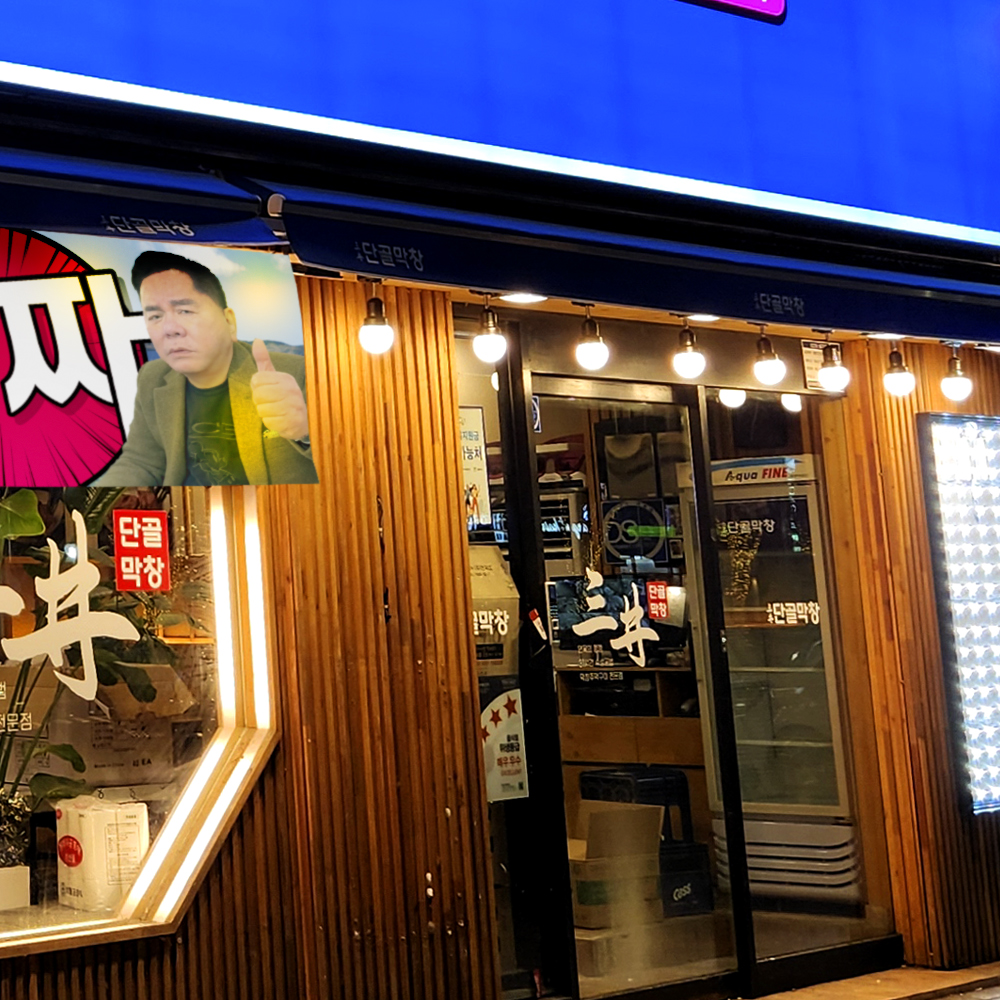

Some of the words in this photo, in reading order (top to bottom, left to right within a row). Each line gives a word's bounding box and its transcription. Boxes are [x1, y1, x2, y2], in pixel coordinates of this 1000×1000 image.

[109, 215, 195, 237] 단골막창
[362, 242, 424, 272] 단골막창
[760, 293, 805, 317] 단골막창
[725, 471, 758, 482] Aqua
[762, 468, 788, 479] FINE
[119, 516, 163, 548] 단골
[728, 519, 775, 535] 단골막창
[120, 556, 165, 589] 막창
[648, 584, 667, 600] 단골
[773, 601, 820, 625] 단골막창
